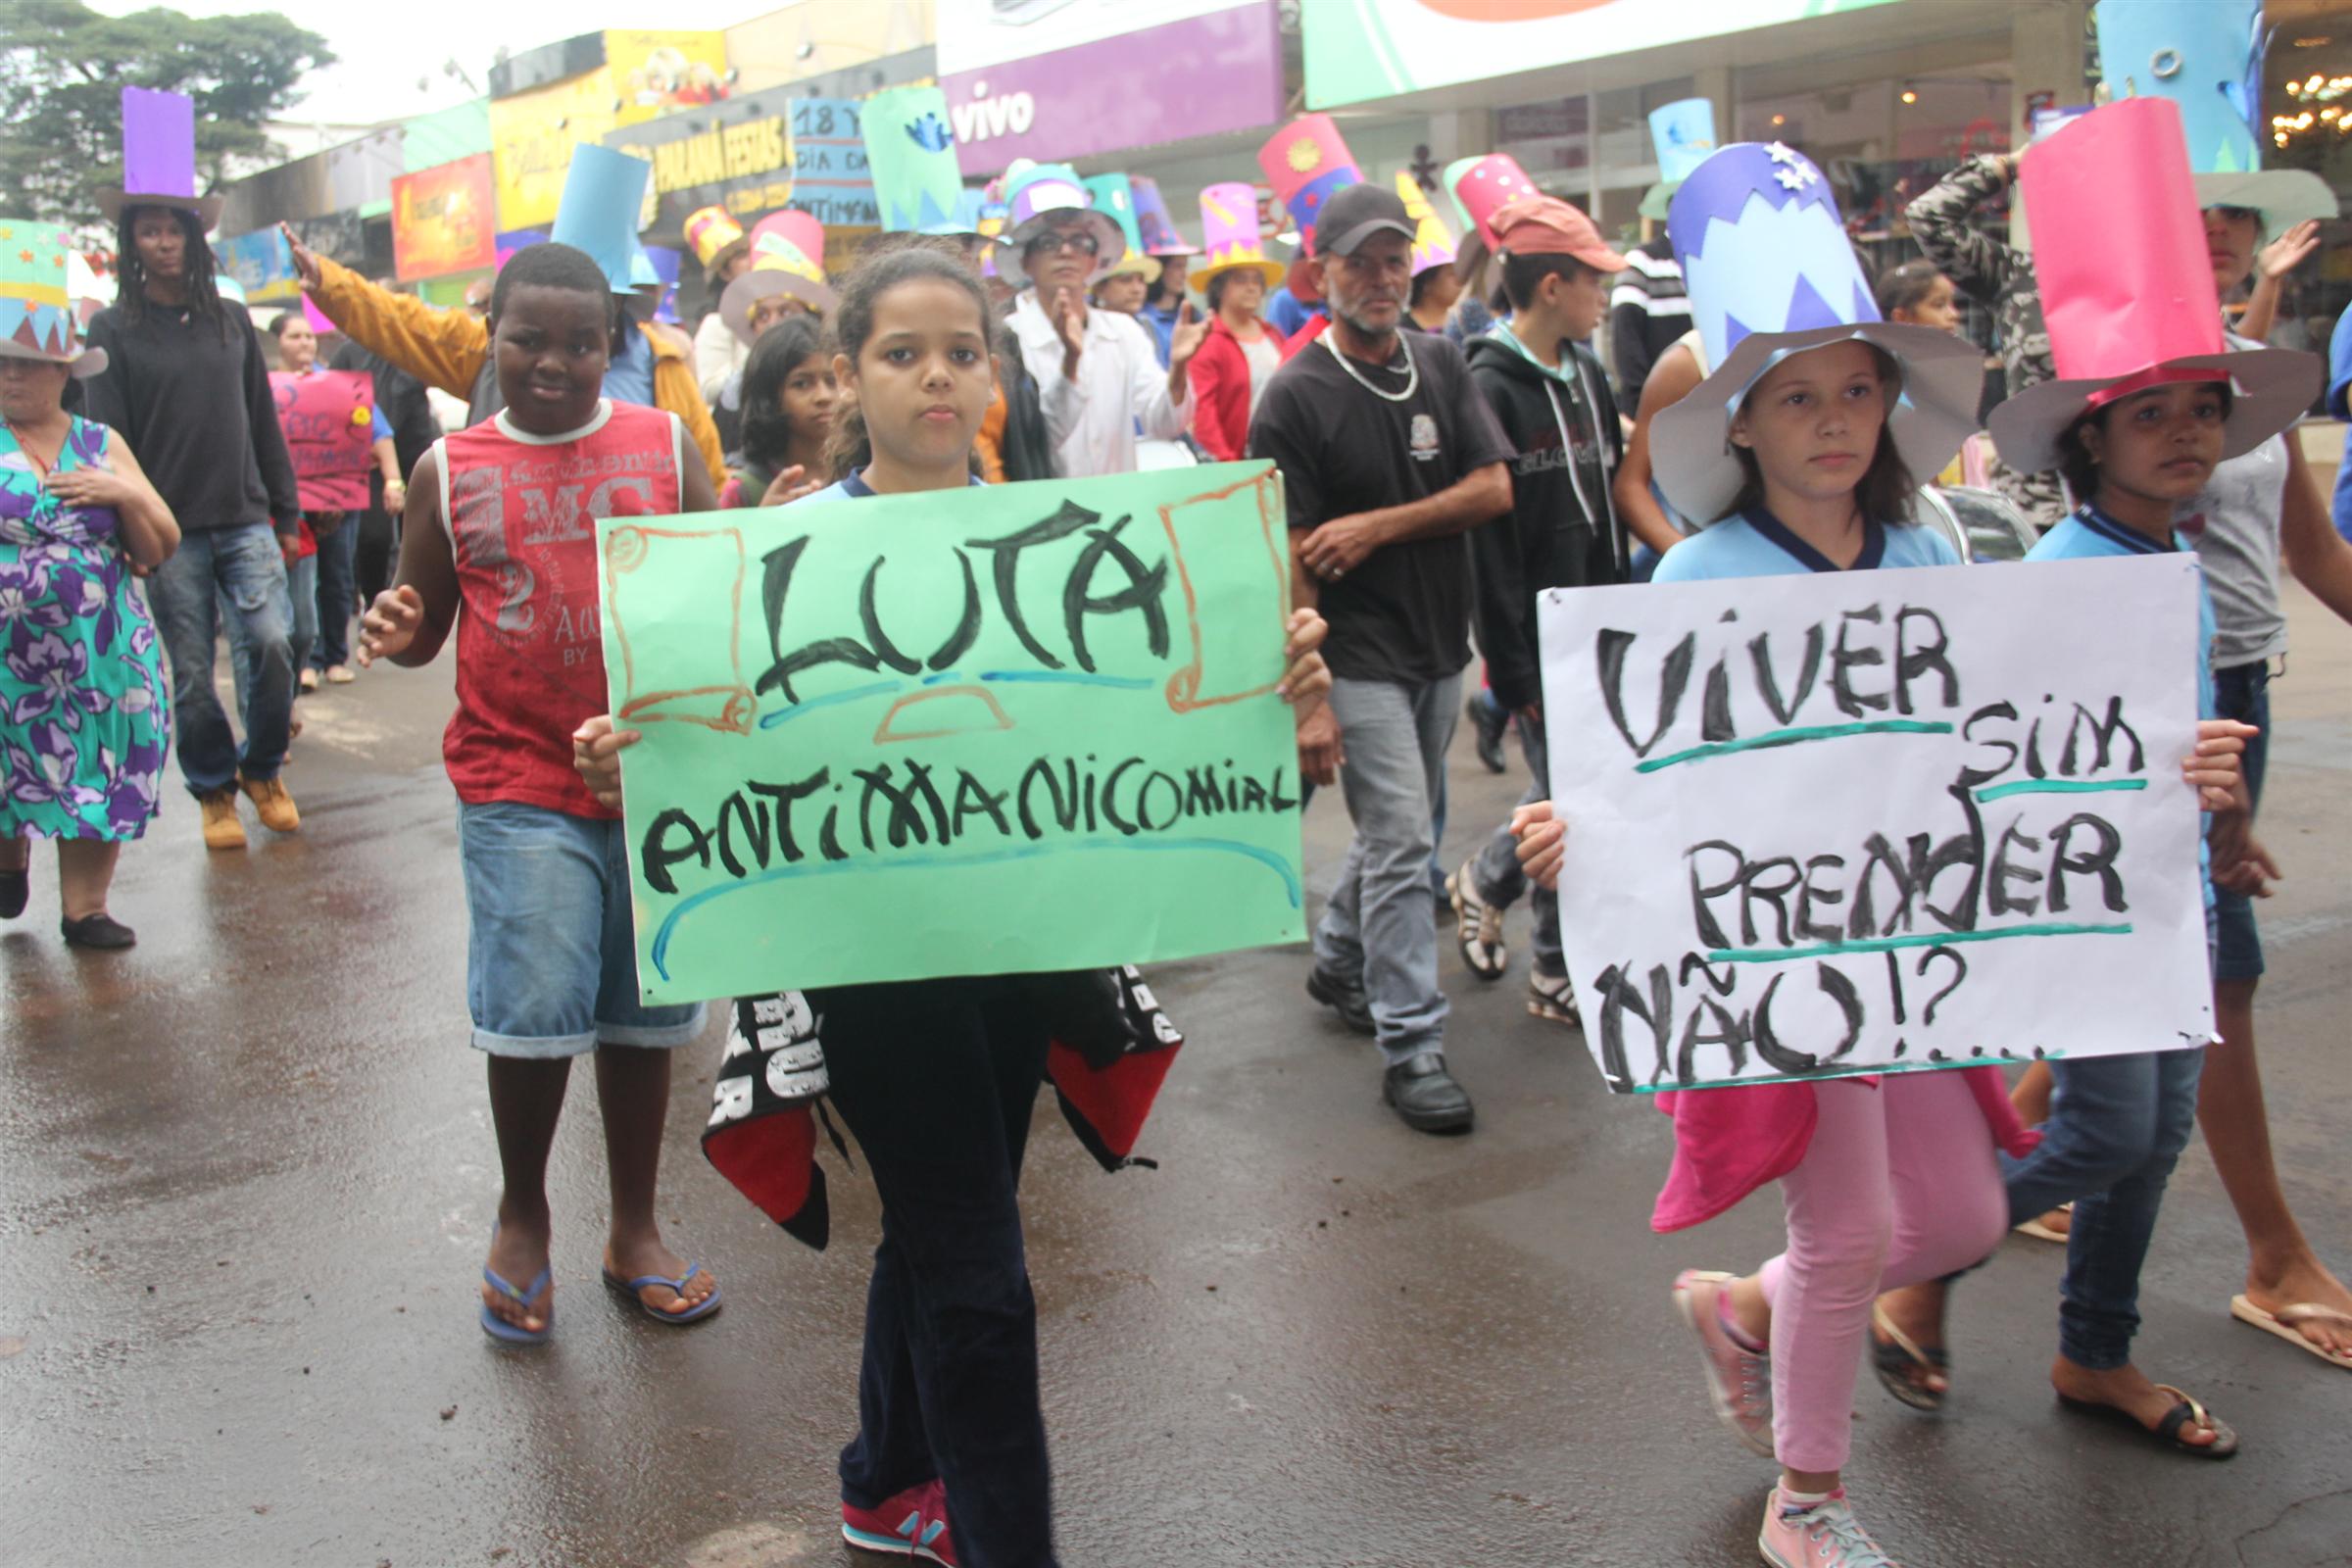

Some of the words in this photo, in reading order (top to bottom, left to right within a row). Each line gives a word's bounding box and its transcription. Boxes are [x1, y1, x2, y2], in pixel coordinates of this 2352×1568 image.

[795, 104, 836, 137] 18
[952, 81, 1035, 144] vivo
[756, 499, 1169, 705] LUTA
